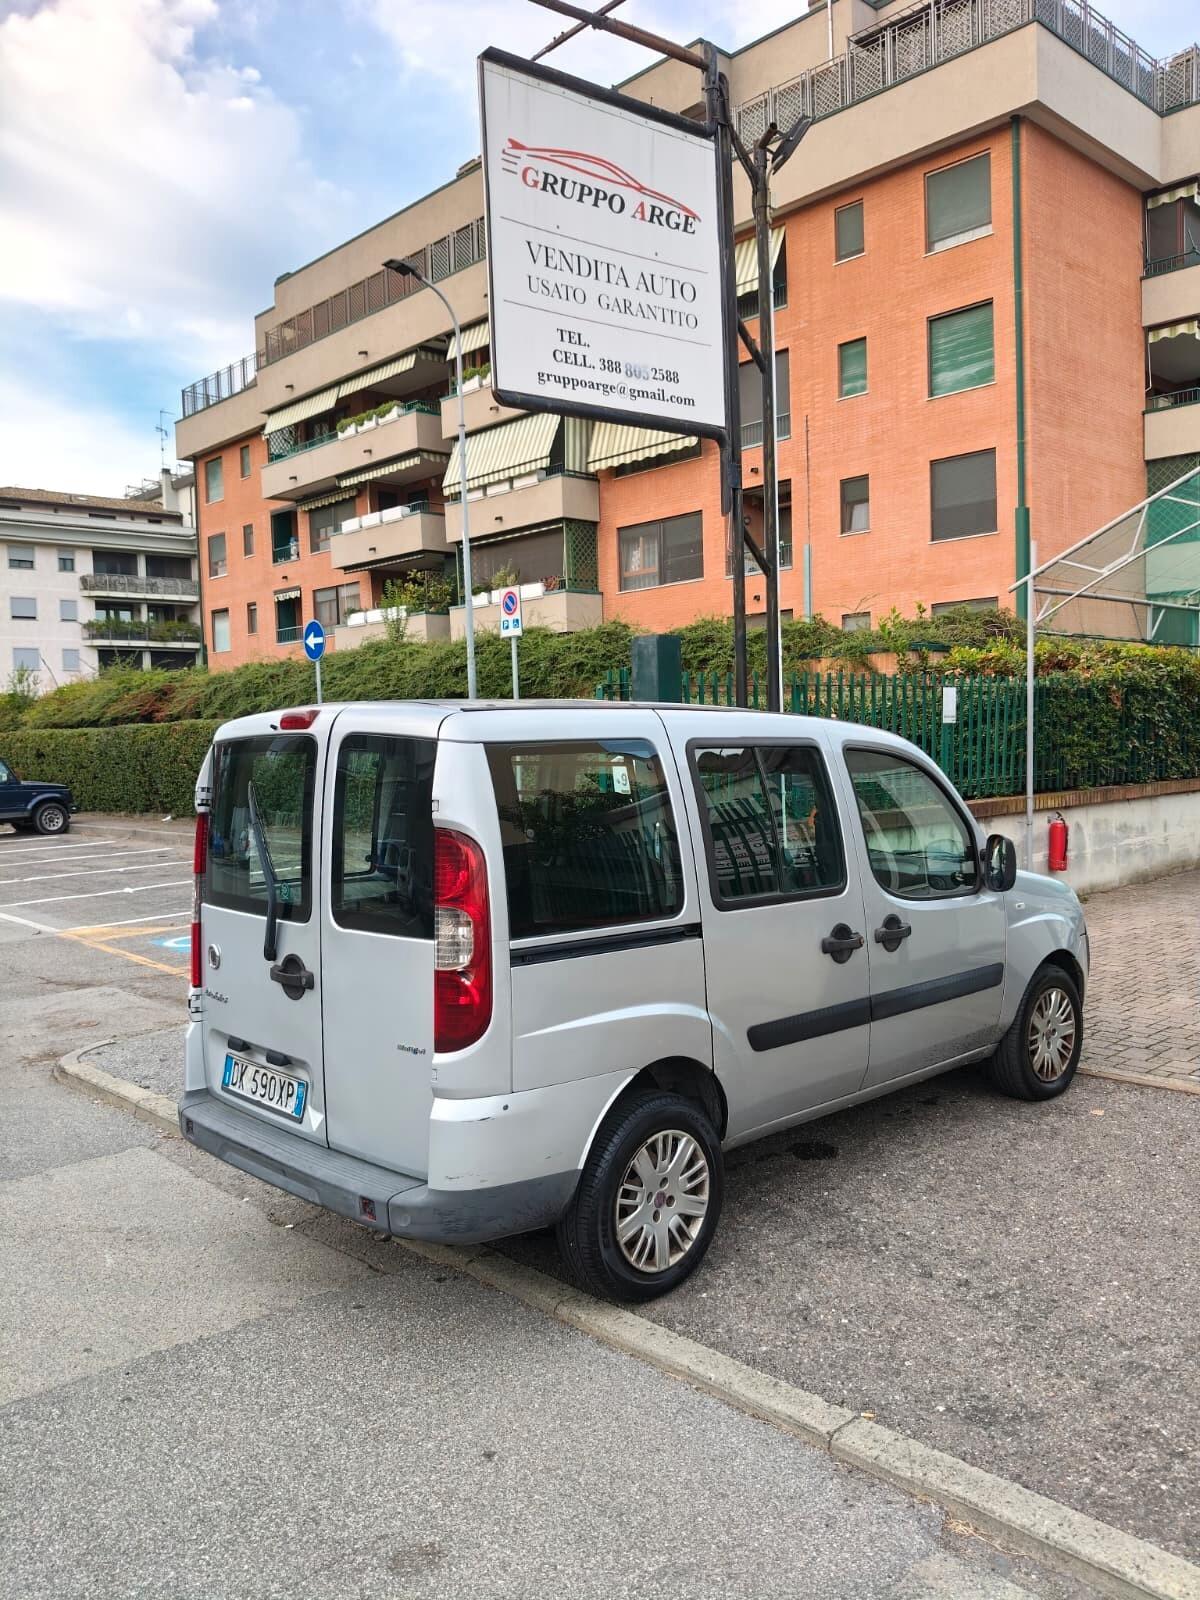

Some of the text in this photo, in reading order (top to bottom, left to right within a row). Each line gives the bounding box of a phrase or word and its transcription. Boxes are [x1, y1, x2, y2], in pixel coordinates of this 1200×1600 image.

[521, 166, 697, 235] GRUPPO ARGE
[525, 240, 697, 304] VENDITA AUTO
[527, 274, 698, 330] USATO GARANTITO
[556, 328, 590, 348] TEL.
[537, 371, 696, 407] gruppoarge@gmail.com
[552, 348, 596, 370] CELL.
[599, 358, 622, 375] 388
[650, 367, 680, 385] 2588
[231, 1060, 295, 1109] DK 590XP
